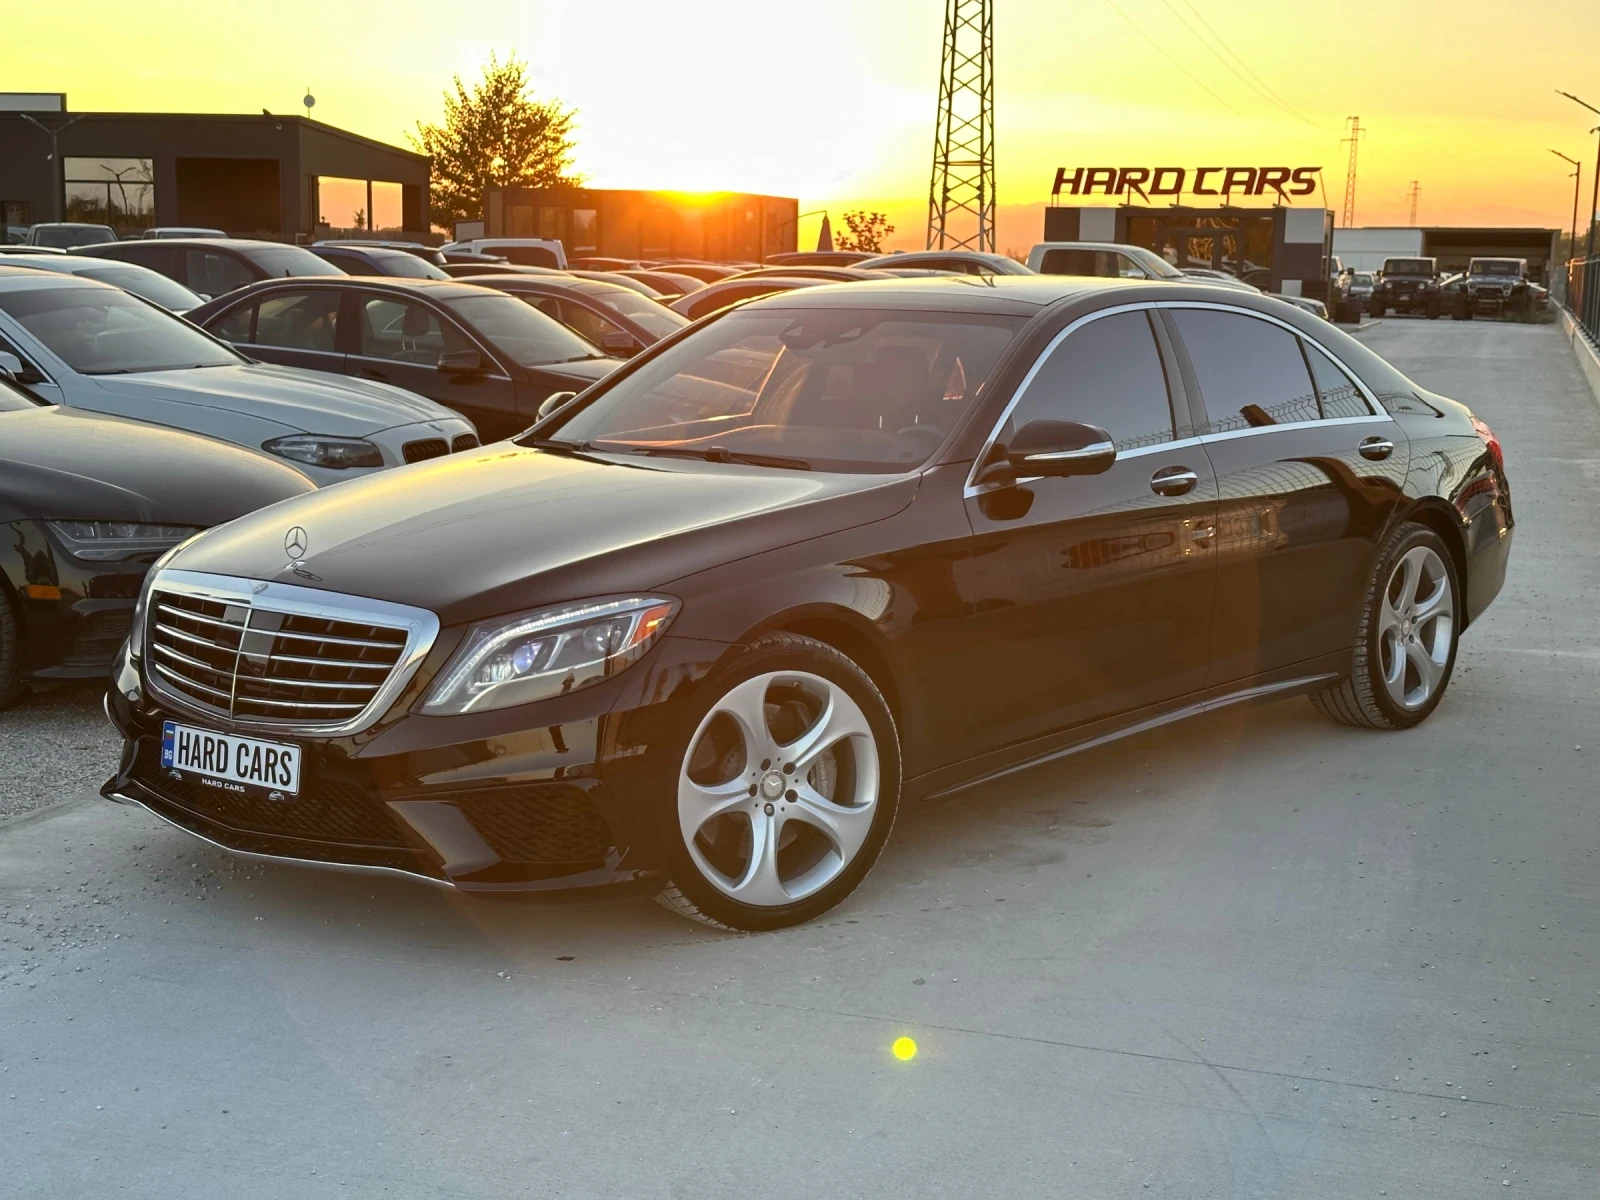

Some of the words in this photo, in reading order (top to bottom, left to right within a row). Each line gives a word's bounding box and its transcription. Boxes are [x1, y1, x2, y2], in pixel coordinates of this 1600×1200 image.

[1051, 167, 1186, 204] HARD
[1192, 167, 1323, 204] CARS
[164, 749, 173, 760] BG
[177, 730, 229, 773] HARD
[235, 742, 292, 787] CARS
[201, 777, 223, 788] HARD
[224, 782, 246, 793] CARS
